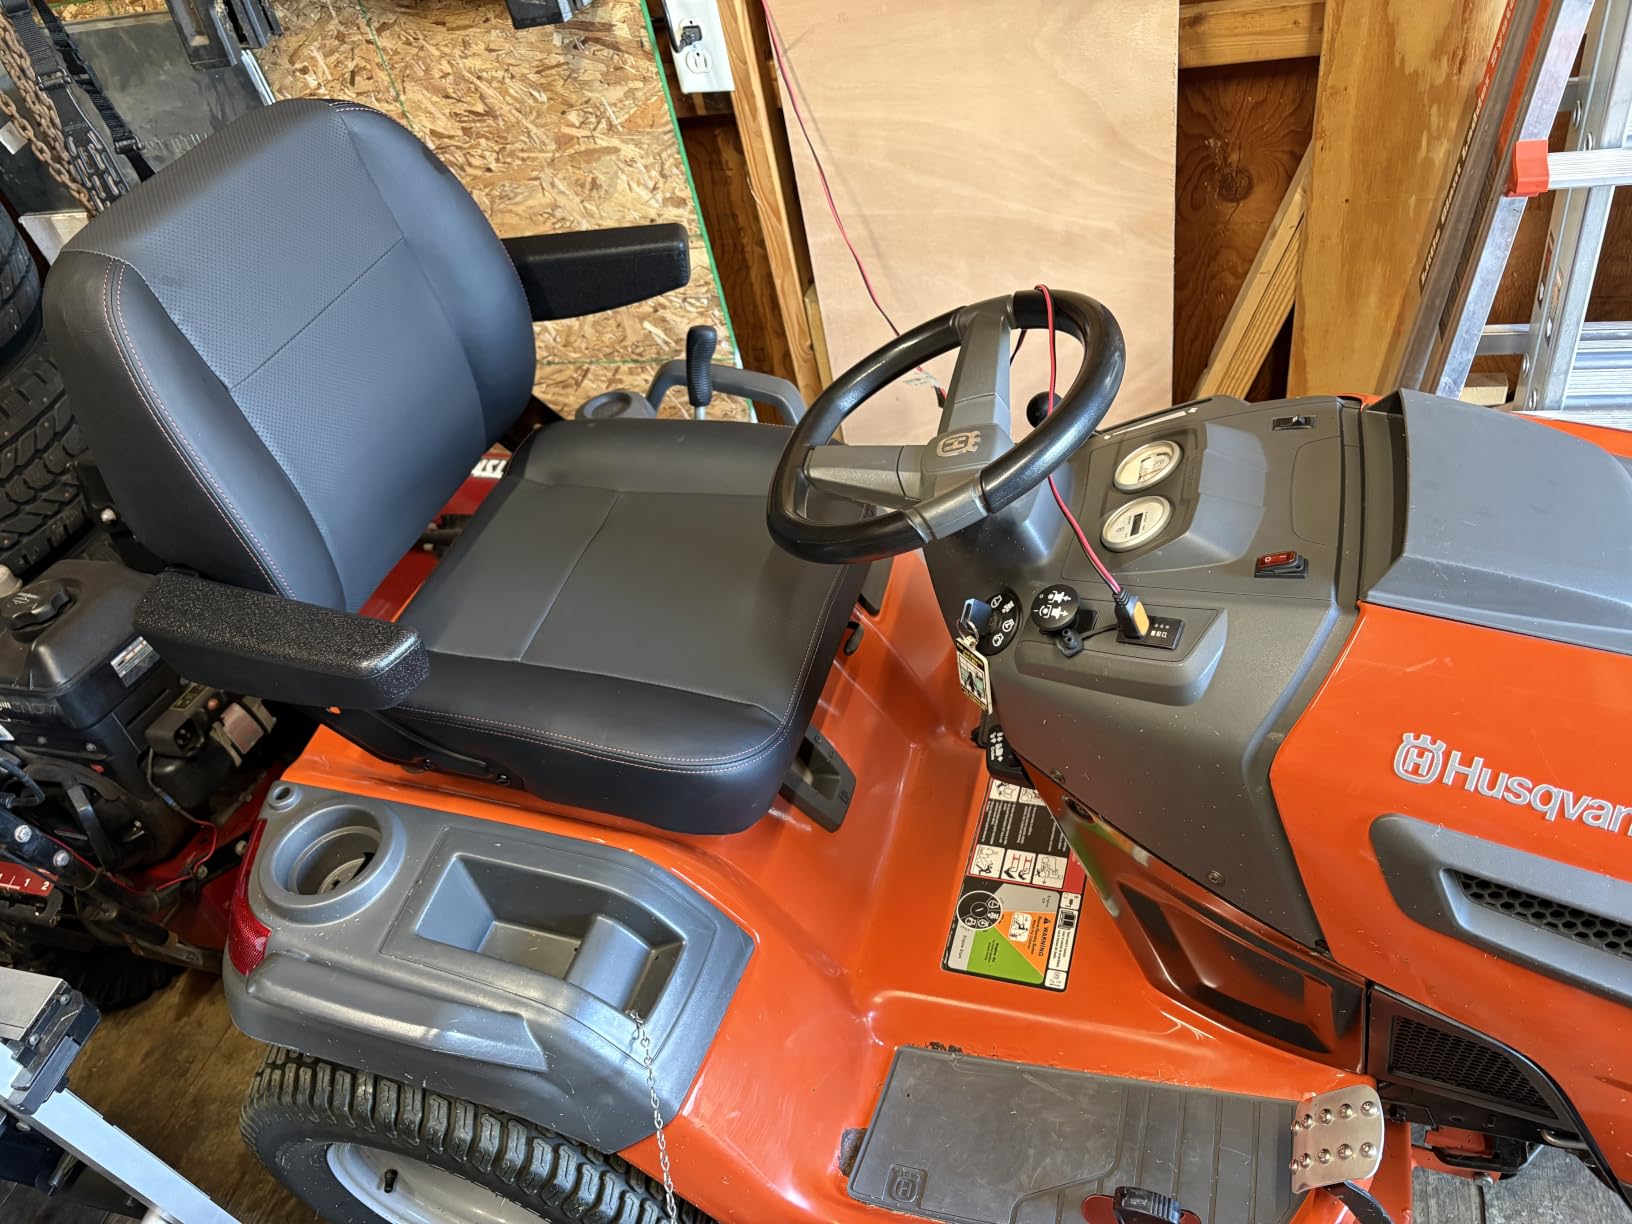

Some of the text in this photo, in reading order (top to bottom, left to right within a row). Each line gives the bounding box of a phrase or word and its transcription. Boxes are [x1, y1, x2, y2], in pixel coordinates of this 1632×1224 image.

[1421, 228, 1441, 286] Little
[1441, 163, 1462, 225] Giant
[1461, 73, 1490, 161] Ladder
[1442, 750, 1632, 836] Husqvar
[24, 877, 31, 888] 1
[40, 880, 50, 891] 2
[1038, 927, 1049, 957] WARNING
